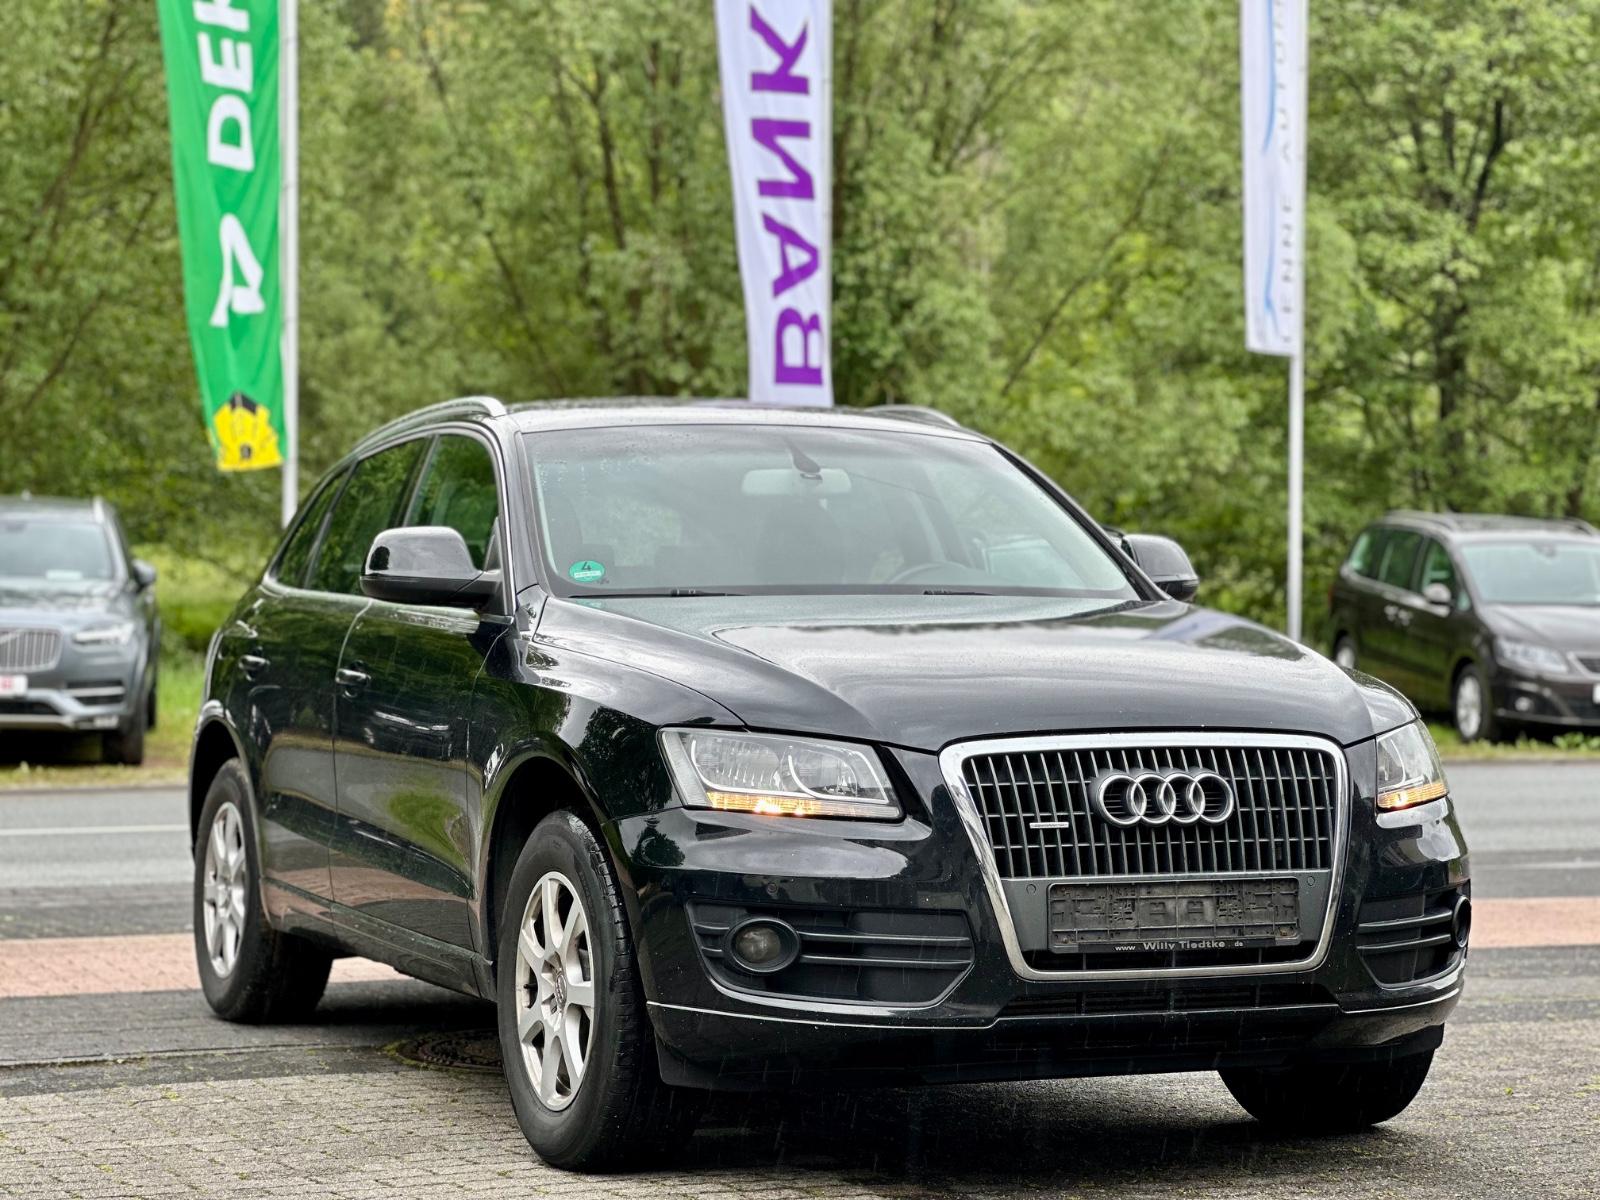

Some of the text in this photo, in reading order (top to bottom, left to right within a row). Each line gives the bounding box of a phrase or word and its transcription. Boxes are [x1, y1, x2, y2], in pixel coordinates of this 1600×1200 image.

[581, 561, 592, 571] 4
[1143, 942, 1176, 950] Willy
[1178, 940, 1226, 949] Tiedtke
